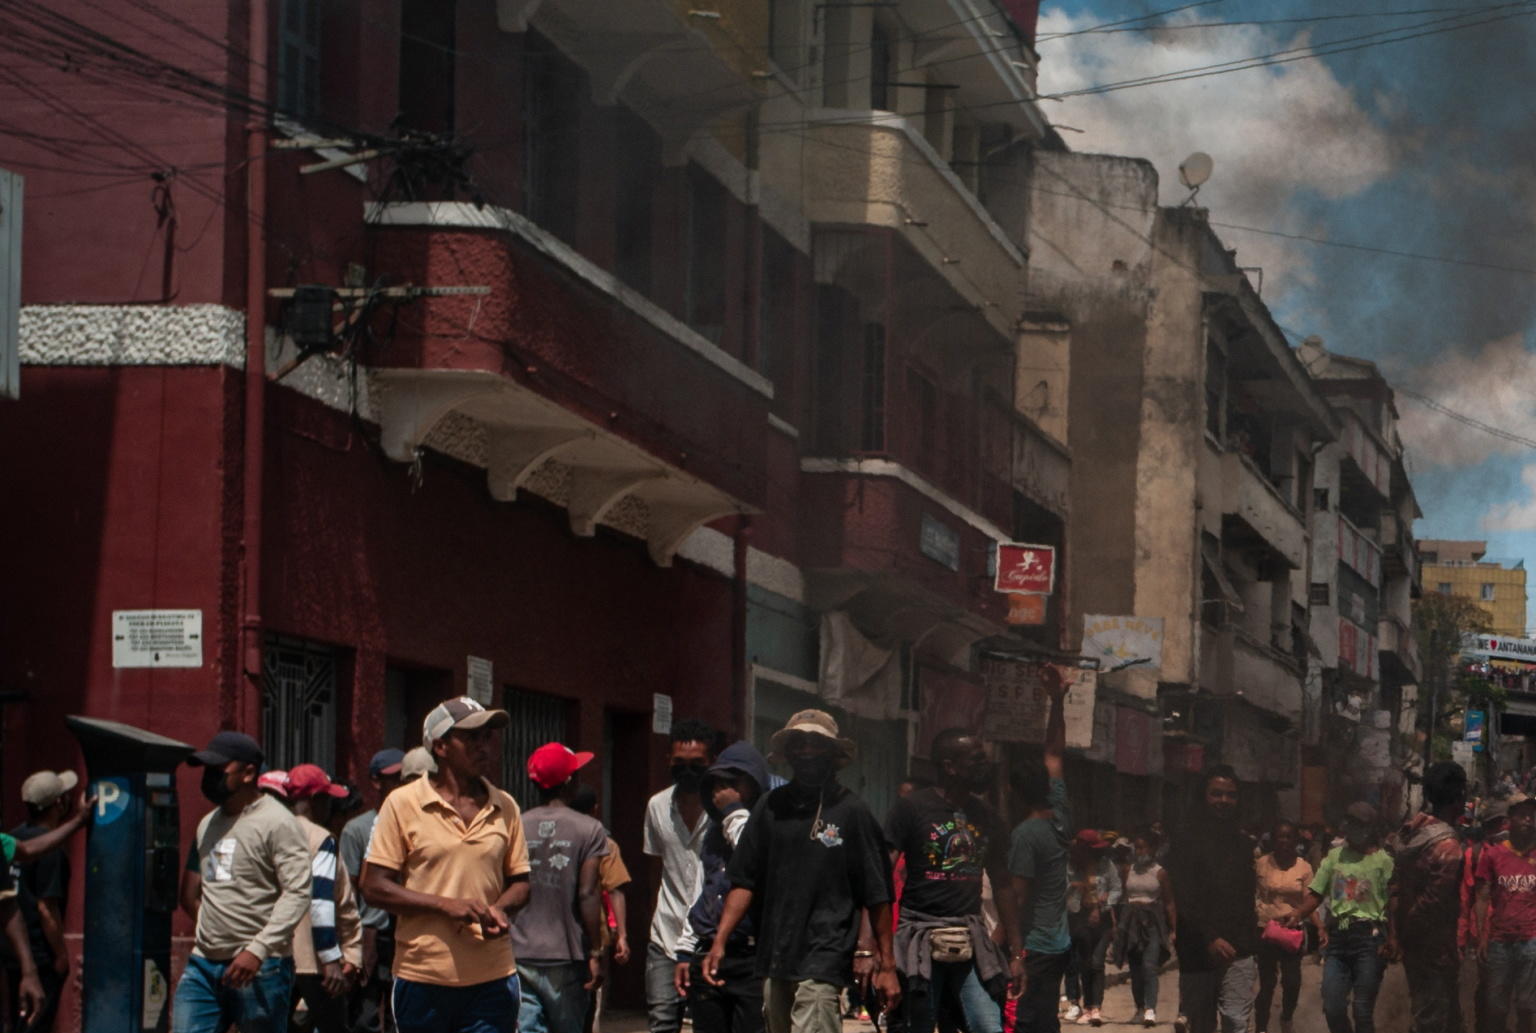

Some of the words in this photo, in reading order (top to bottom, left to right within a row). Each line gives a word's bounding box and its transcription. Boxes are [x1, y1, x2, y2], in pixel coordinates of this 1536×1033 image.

[1478, 639, 1489, 649] WE
[97, 780, 120, 817] P
[1498, 874, 1536, 888] QATAR
